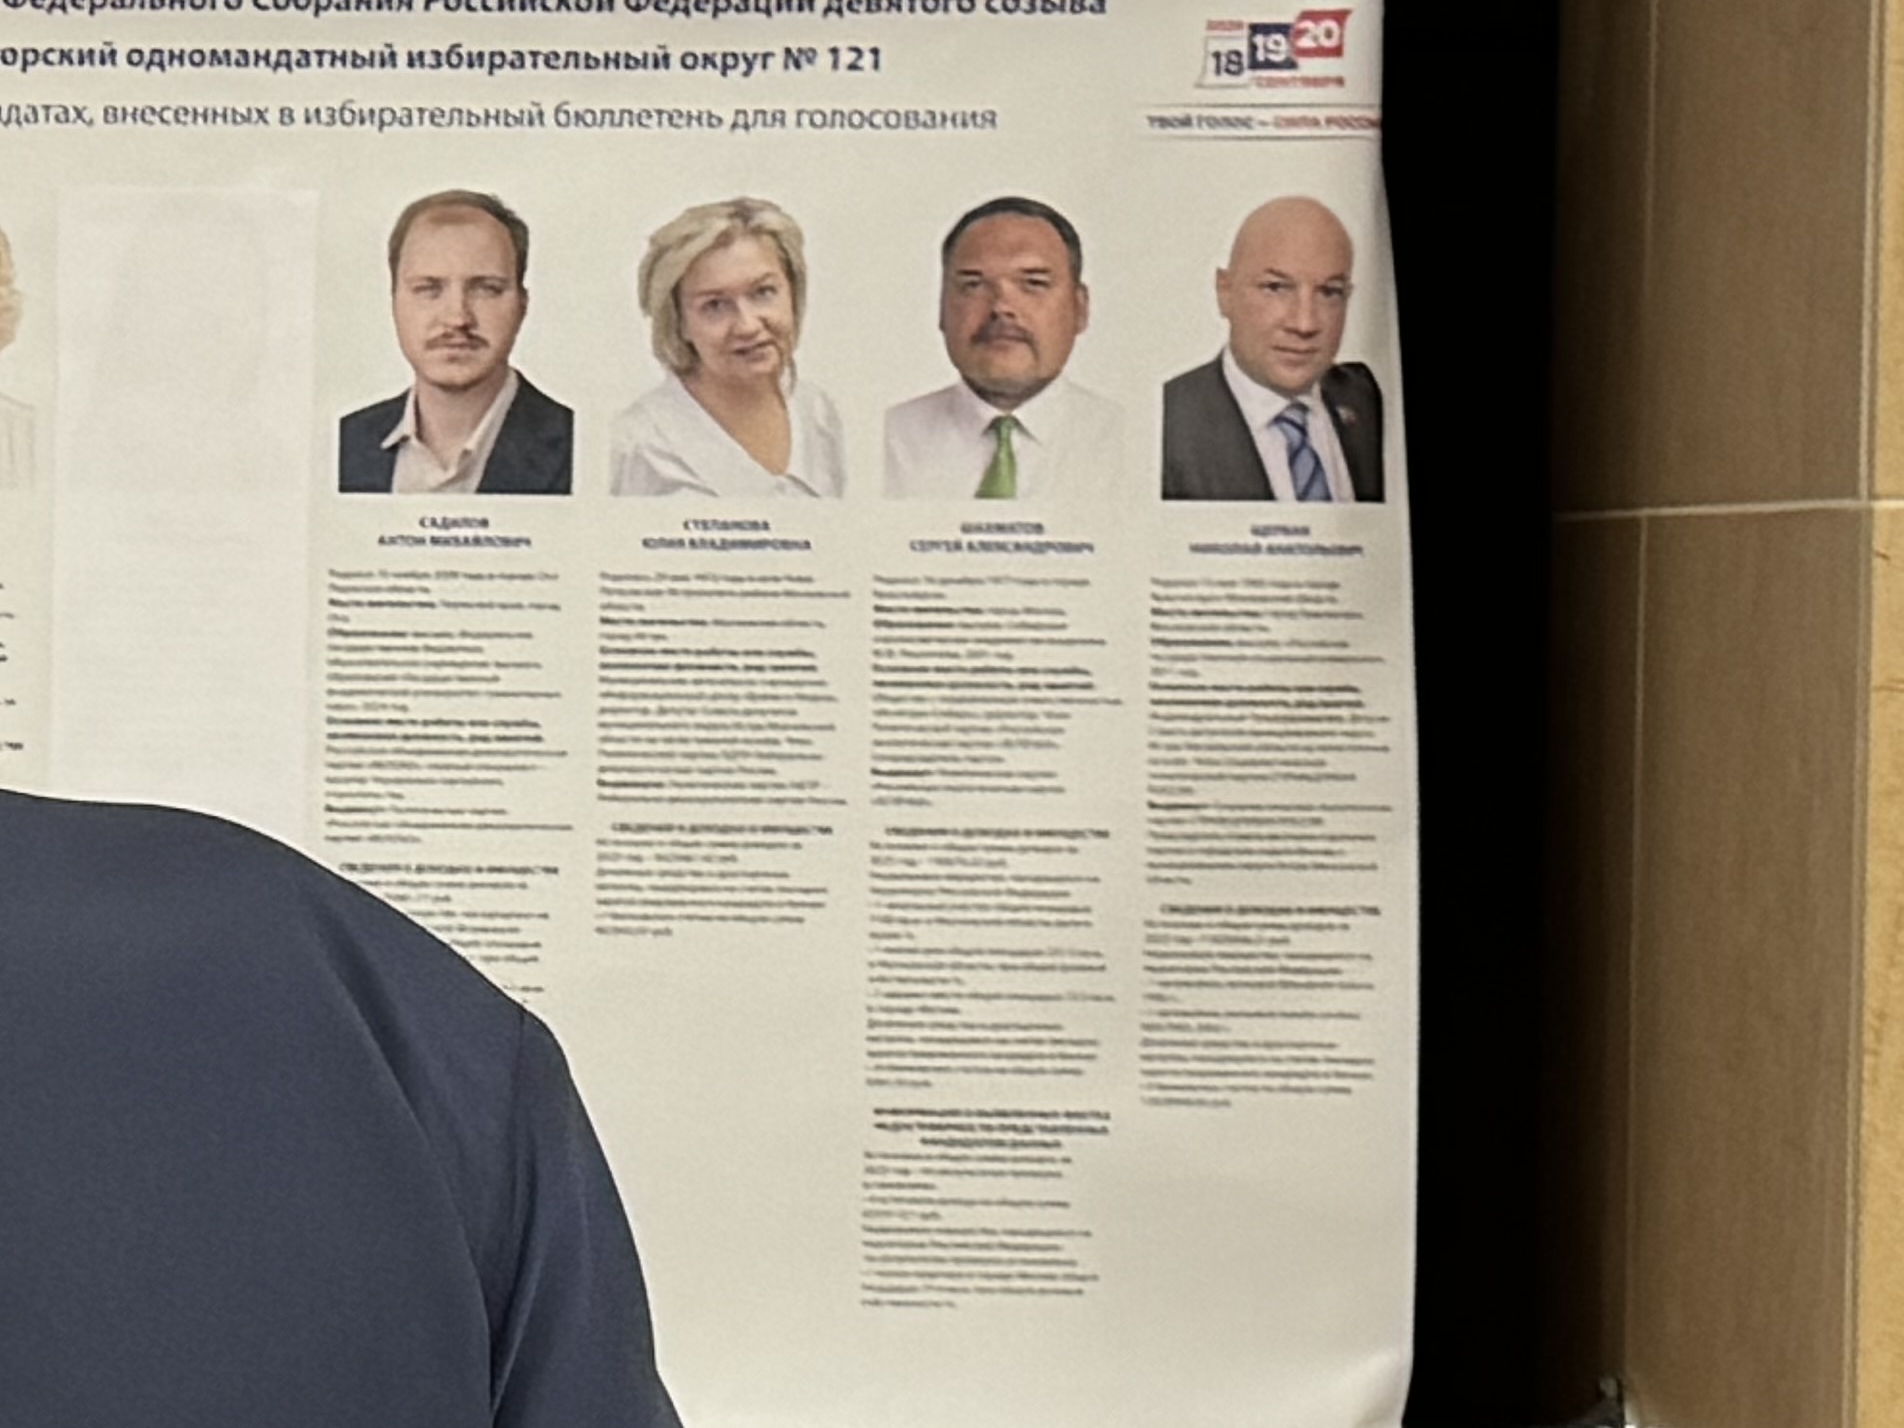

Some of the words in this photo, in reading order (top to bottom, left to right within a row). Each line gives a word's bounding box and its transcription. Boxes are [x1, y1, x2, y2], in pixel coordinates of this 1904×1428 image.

[1252, 32, 1290, 62] 19
[1295, 19, 1341, 48] 20
[126, 41, 396, 73] одномандатный
[406, 43, 671, 75] избирательный
[679, 50, 776, 77] округ
[827, 46, 882, 71] 121
[1211, 49, 1245, 76] 18
[103, 104, 270, 128] внесенных
[279, 106, 295, 127] в
[302, 102, 546, 133] избирательный
[553, 102, 724, 130] бюллетень
[729, 109, 786, 133] для
[795, 108, 999, 131] голосования
